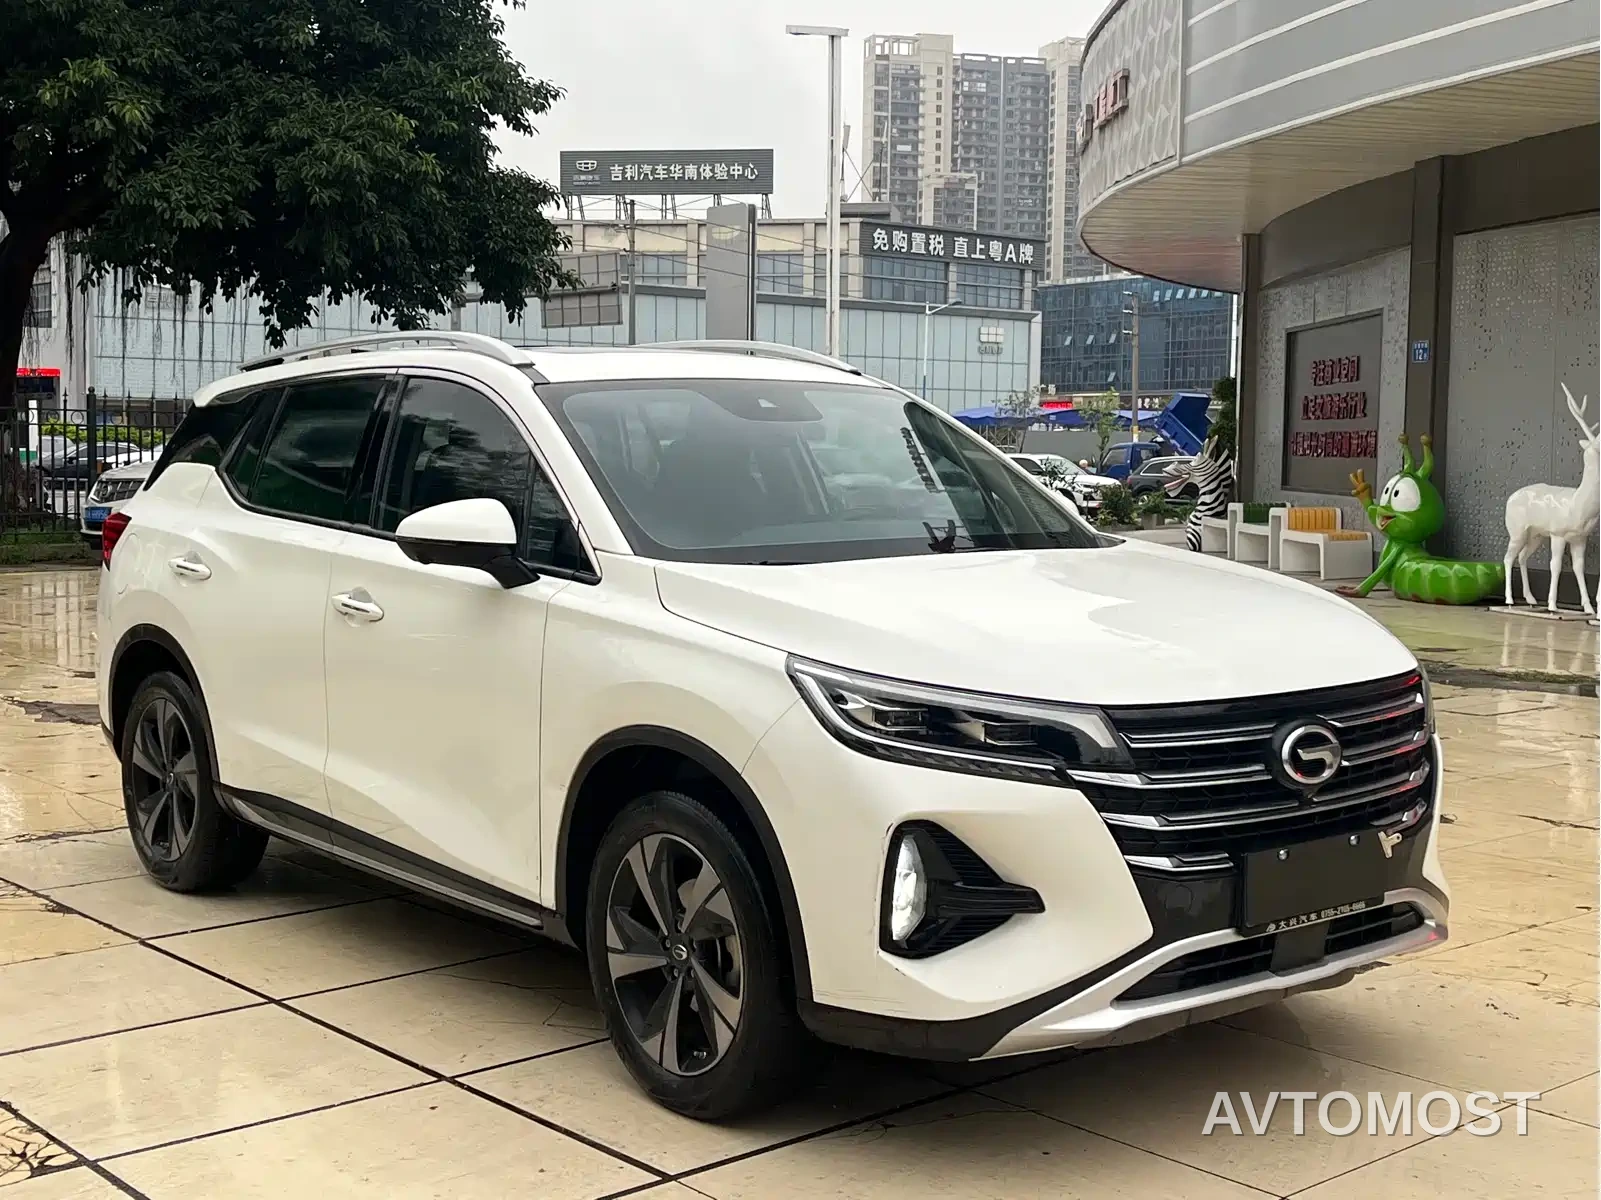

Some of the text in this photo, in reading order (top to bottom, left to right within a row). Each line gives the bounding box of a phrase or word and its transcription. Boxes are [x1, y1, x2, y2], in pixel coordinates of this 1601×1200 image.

[609, 162, 759, 181] 吉利汽车华南体验中心
[872, 227, 1034, 265] 免购置税 直上粤A牌
[1278, 912, 1318, 930] 大兴汽车
